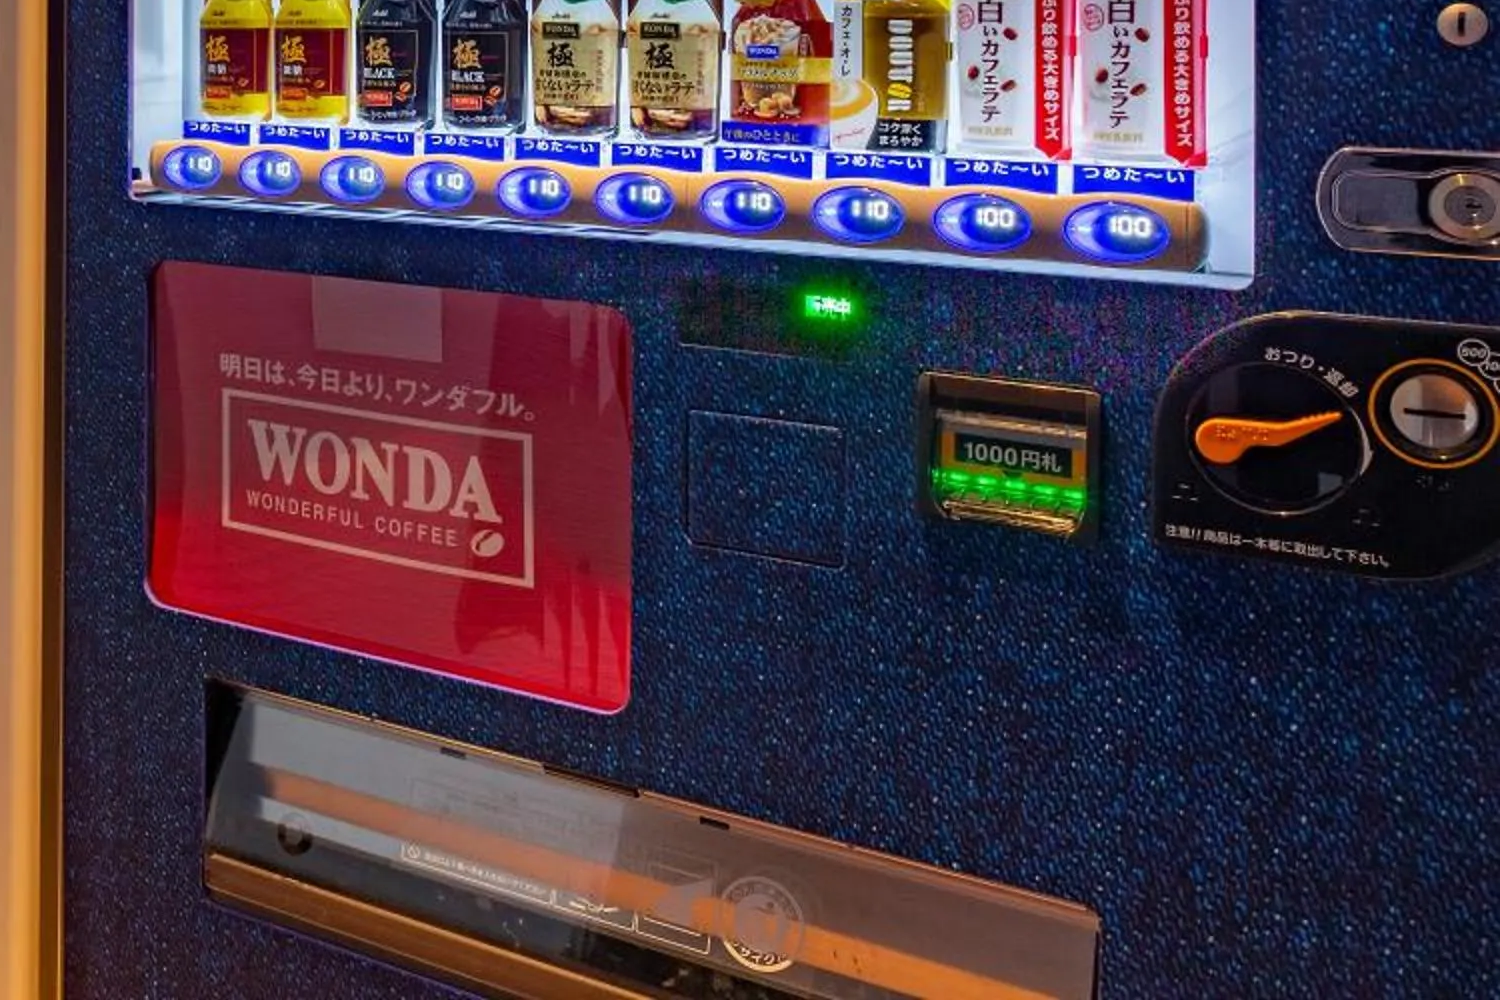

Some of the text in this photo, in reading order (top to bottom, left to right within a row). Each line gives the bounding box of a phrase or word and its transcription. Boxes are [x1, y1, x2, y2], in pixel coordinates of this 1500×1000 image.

[452, 38, 482, 69] 極
[547, 42, 575, 68] 極
[645, 42, 675, 69] 極
[878, 122, 922, 135] コク深く
[878, 135, 924, 147] まろやか
[189, 157, 212, 171] 110
[267, 162, 291, 177] 110
[349, 168, 374, 182] 110
[435, 174, 463, 189] 110
[529, 179, 558, 195] 110
[630, 186, 660, 202] 110
[737, 194, 771, 210] 110
[852, 201, 888, 219] 110
[976, 208, 1014, 226] 100
[1109, 216, 1151, 236] 100
[1265, 347, 1359, 398] おつり・返却
[219, 352, 536, 422] 明日は、今日より、ワンダフル。
[963, 441, 1062, 474] 1000円札
[246, 419, 503, 524] WONDA
[246, 489, 459, 548] WONDERFUL COFFEE
